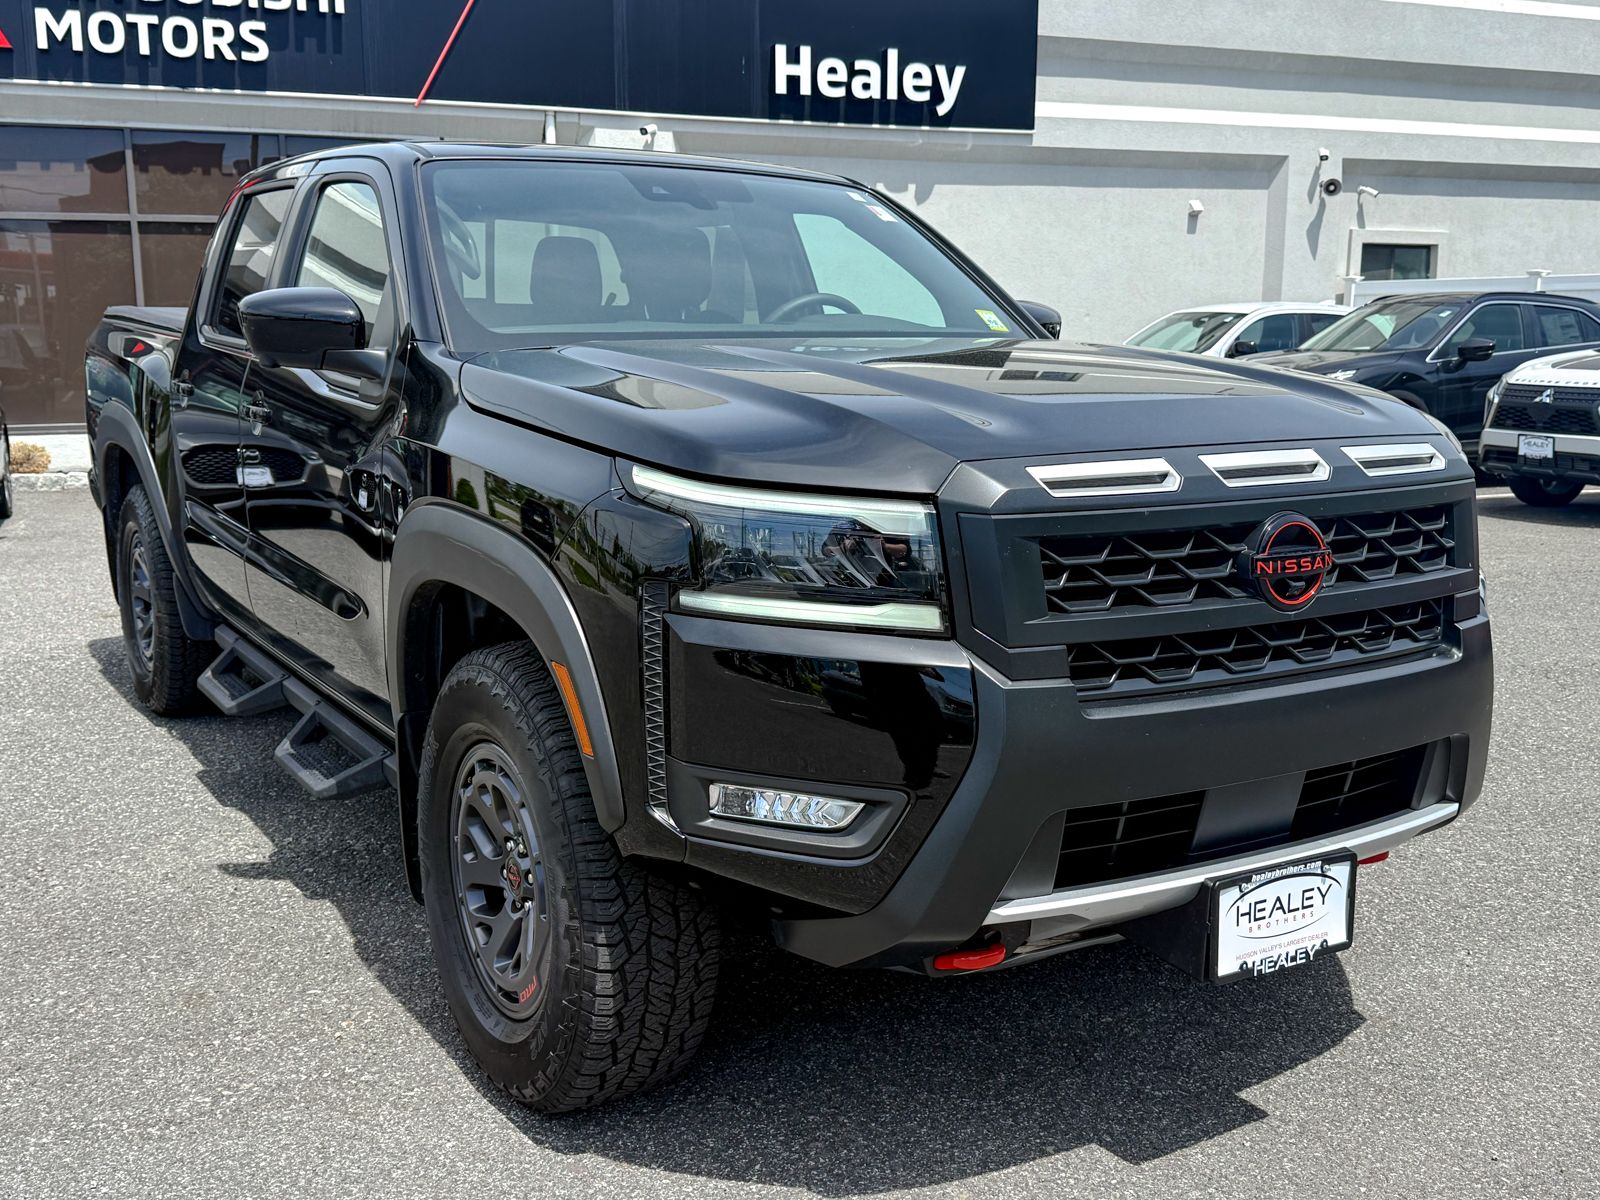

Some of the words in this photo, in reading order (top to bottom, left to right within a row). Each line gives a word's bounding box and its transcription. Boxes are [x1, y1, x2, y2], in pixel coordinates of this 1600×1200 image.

[34, 7, 270, 62] MOTORS
[774, 43, 967, 117] Healey
[1524, 440, 1549, 448] HEALEY
[1256, 555, 1332, 574] NISSAN
[1251, 861, 1322, 882] healeybrothers.com
[1236, 884, 1333, 927] HEALEY
[1248, 911, 1315, 934] BROTHERS
[1236, 949, 1258, 962] HUDSON
[1259, 942, 1283, 956] VALLEY'S
[1283, 936, 1307, 949] LARGEST
[1307, 931, 1329, 943] DEALER
[1253, 944, 1317, 977] HEALEY
